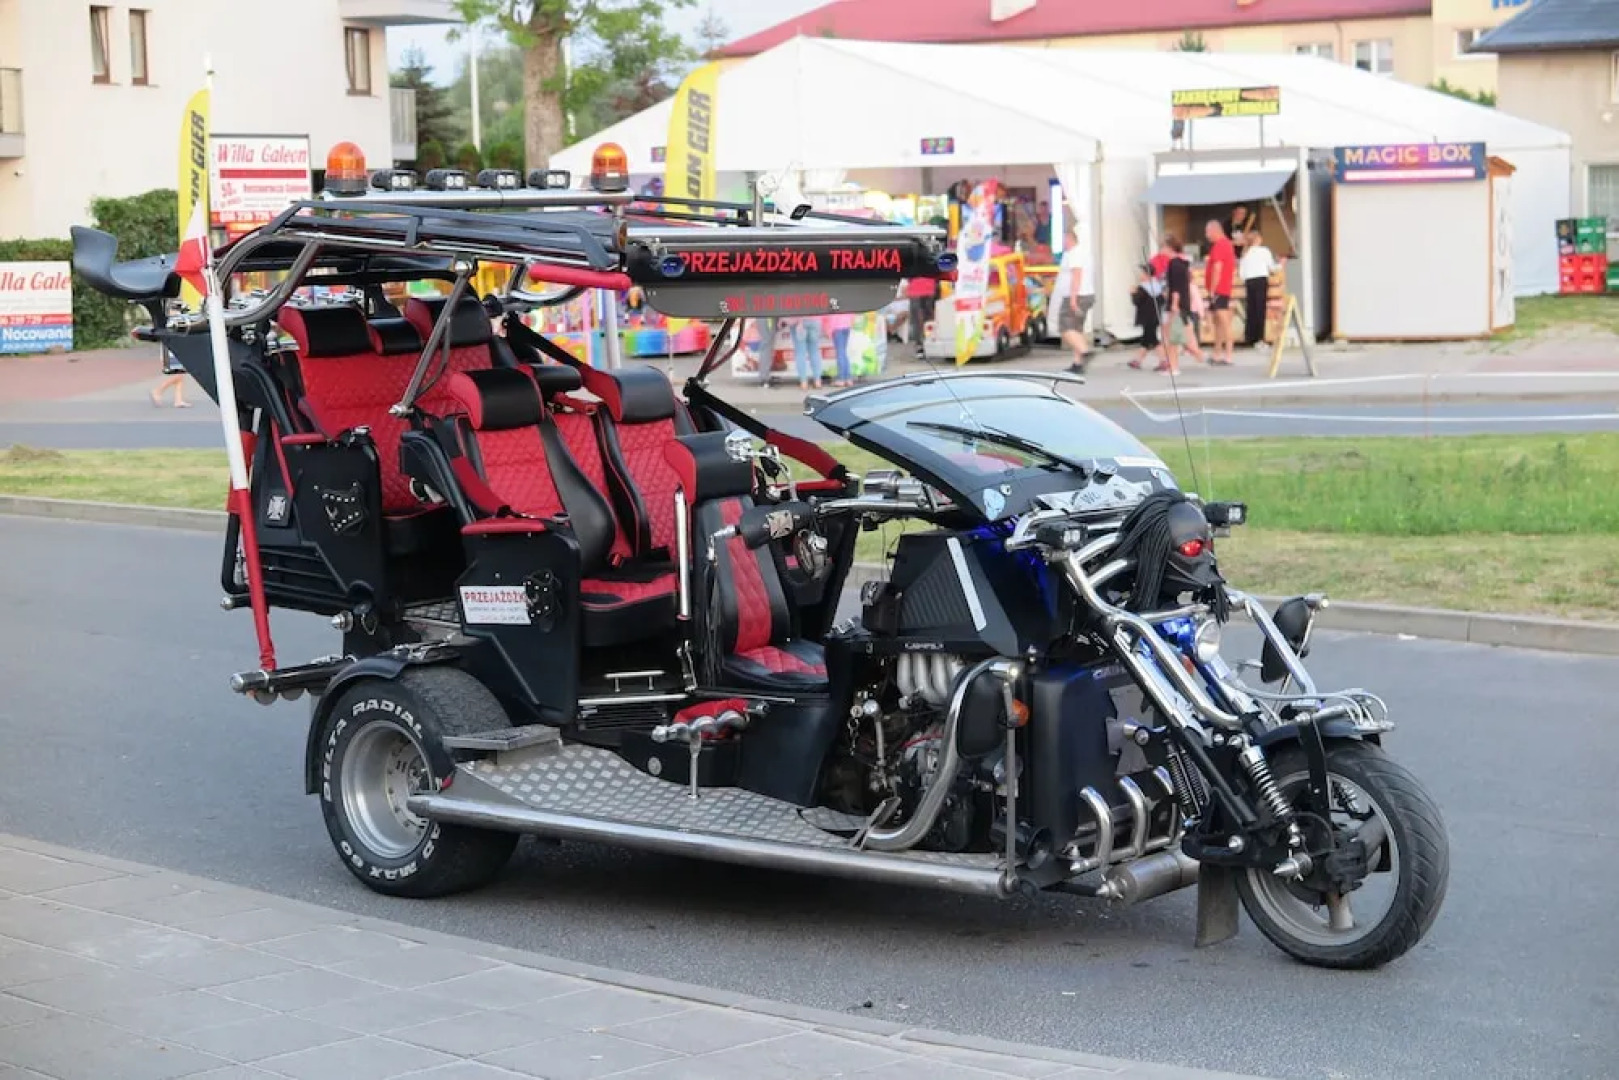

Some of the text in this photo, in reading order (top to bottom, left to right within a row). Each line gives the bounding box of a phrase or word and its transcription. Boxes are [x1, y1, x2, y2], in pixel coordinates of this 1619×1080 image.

[687, 87, 711, 154] GIER
[190, 109, 205, 169] GIER
[218, 144, 307, 163] Willa Galeon
[1344, 144, 1472, 165] MAGIC BOX
[678, 248, 901, 273] PRZEJAŻDŻKA TRAJKĄ
[464, 590, 528, 603] PRZEJAŻDŻK
[323, 699, 423, 801] DELTA RADIAL
[369, 860, 417, 880] MAX
